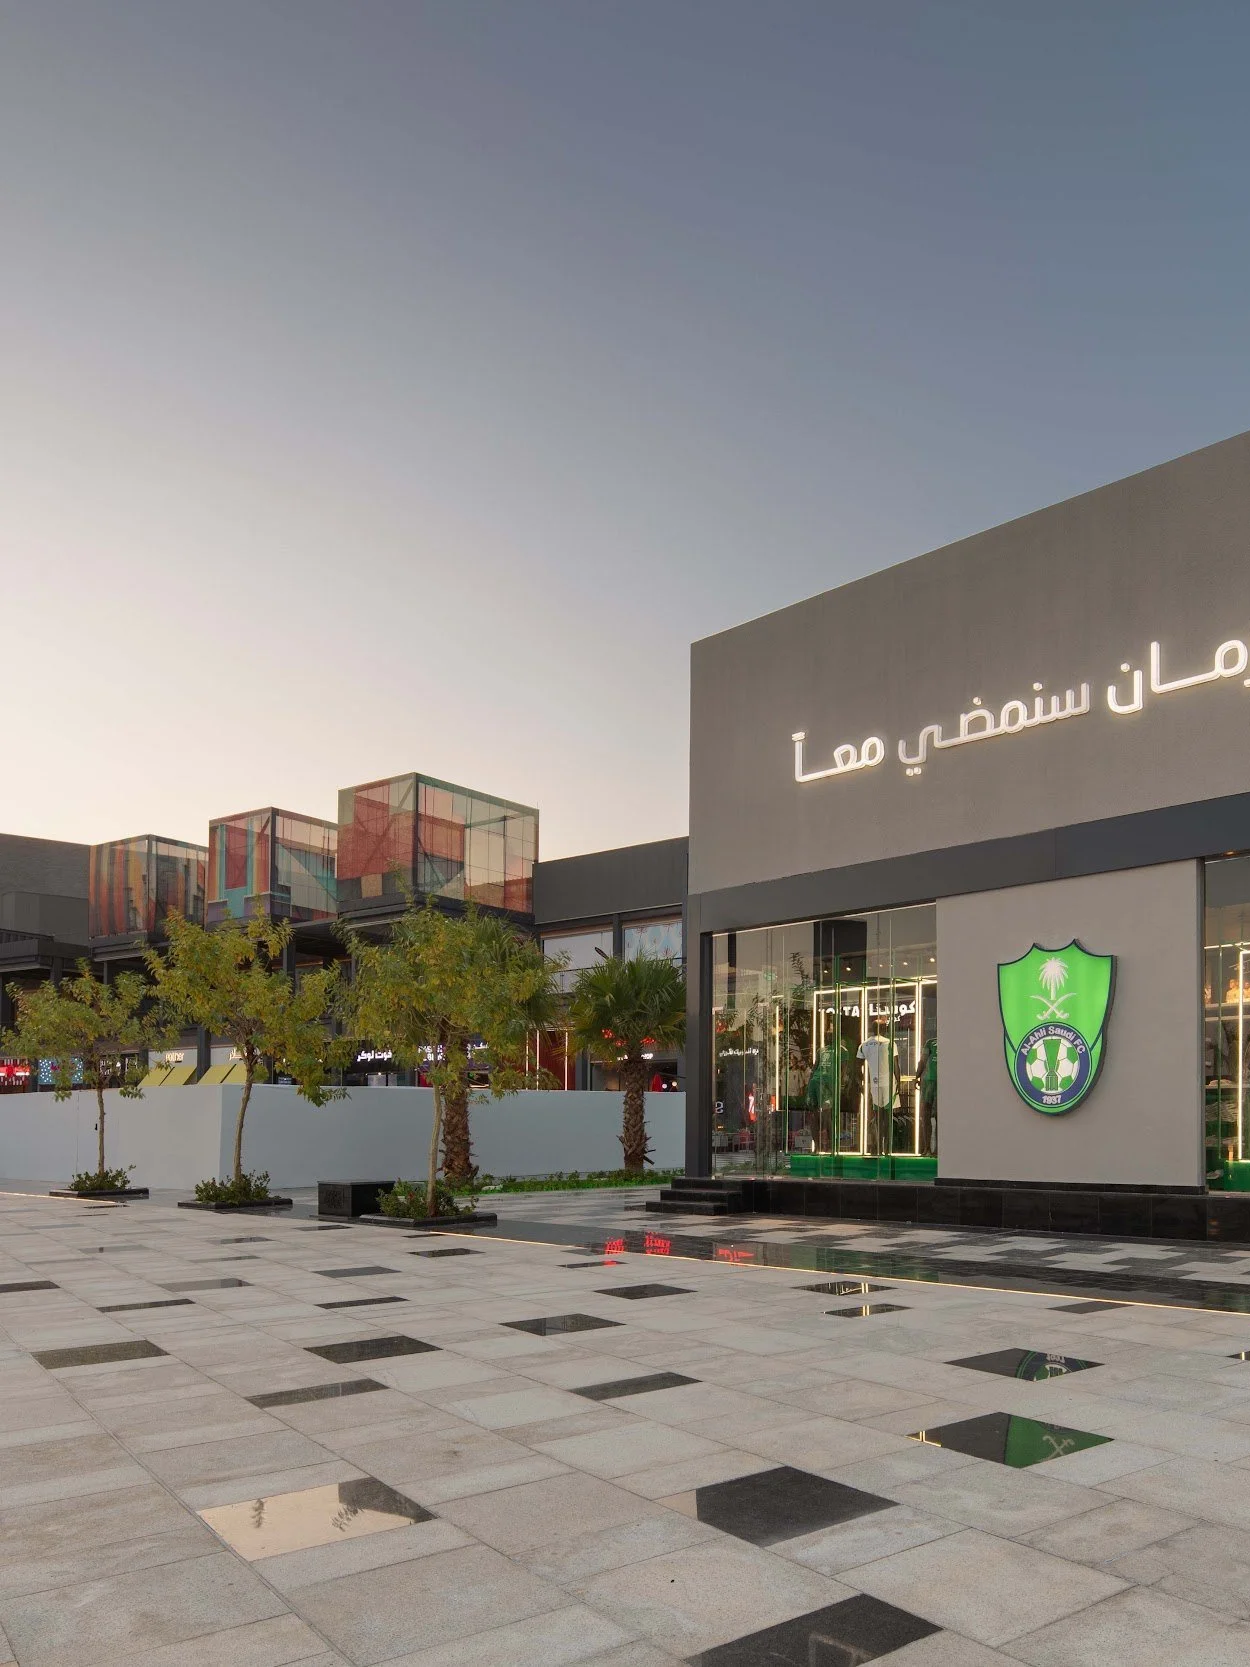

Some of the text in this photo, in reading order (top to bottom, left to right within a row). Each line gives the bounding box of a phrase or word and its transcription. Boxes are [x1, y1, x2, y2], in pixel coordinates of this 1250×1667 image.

[897, 682, 1090, 777] سنمضي
[1020, 1025, 1086, 1056] Al-Ahli Saudi FC
[1042, 1095, 1062, 1104] 1937
